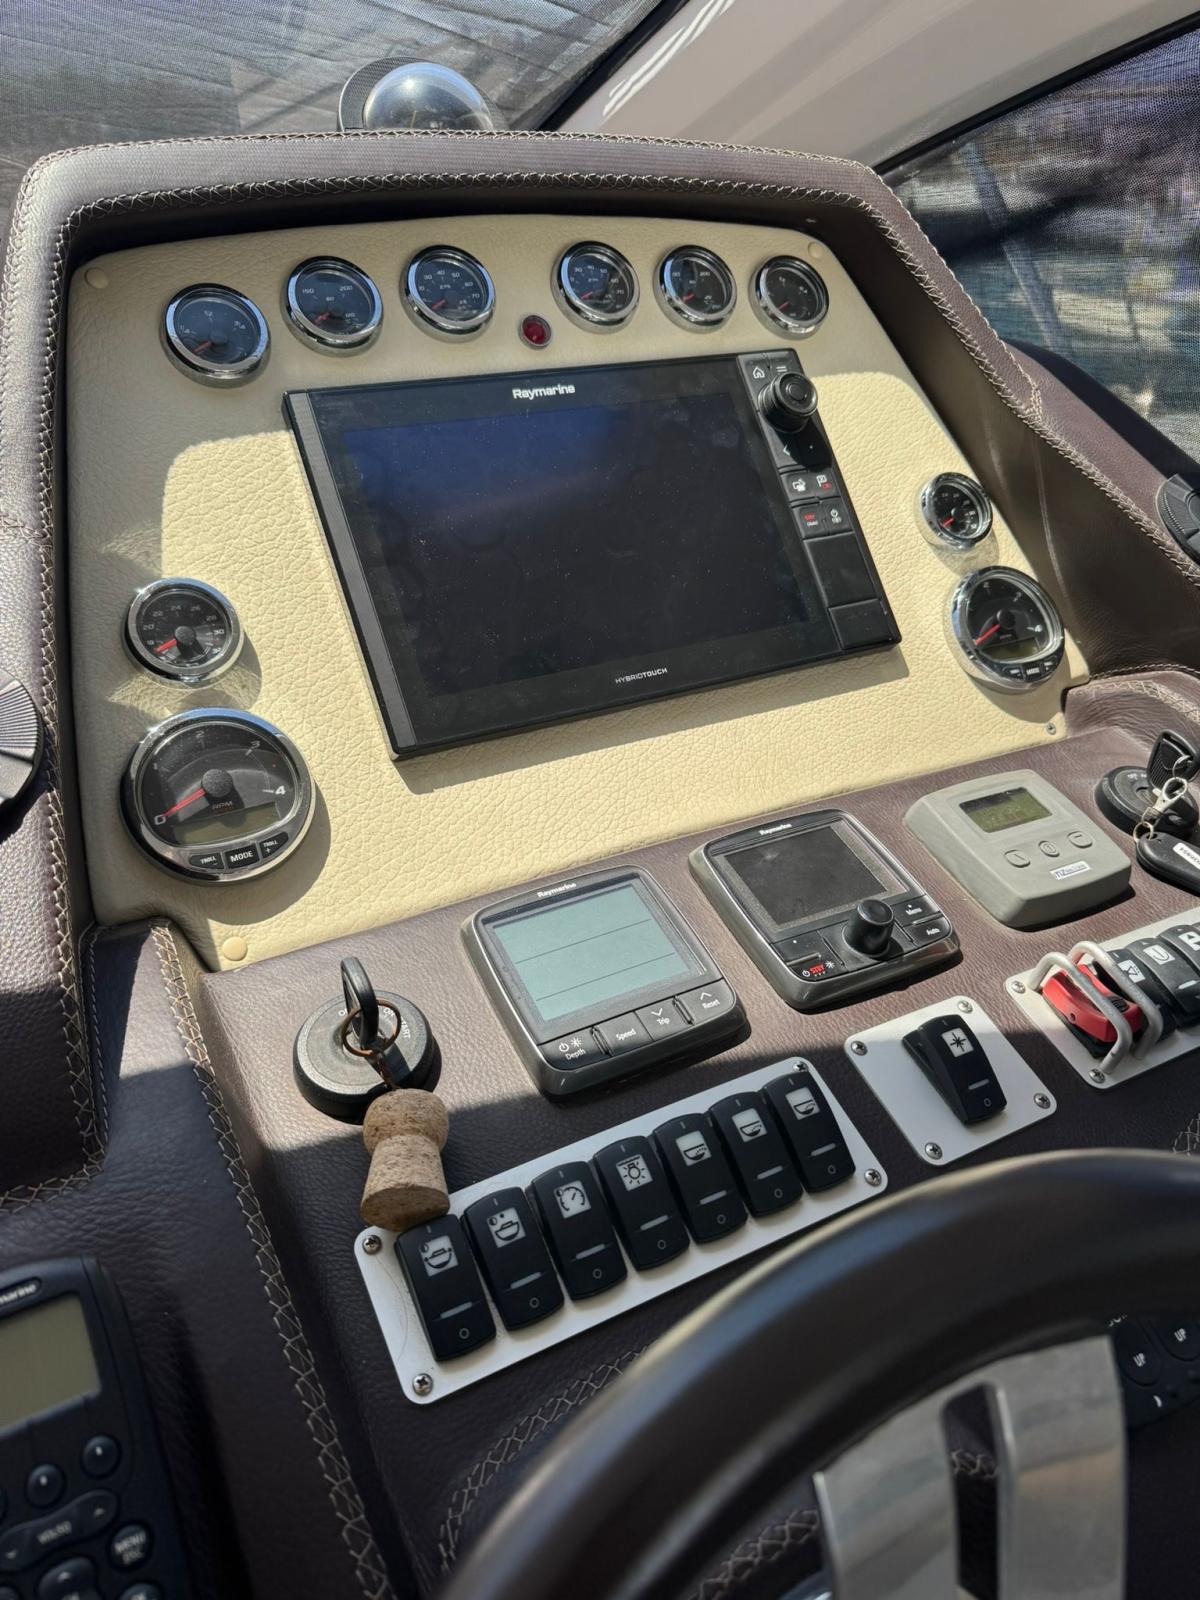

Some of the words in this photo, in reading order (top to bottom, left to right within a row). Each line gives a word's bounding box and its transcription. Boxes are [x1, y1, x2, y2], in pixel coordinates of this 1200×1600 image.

[511, 383, 577, 401] Raymarine
[251, 740, 260, 749] 3
[275, 786, 286, 795] 4
[154, 815, 166, 825] 0
[230, 851, 254, 863] MODE
[536, 883, 577, 898] Raymarine
[702, 999, 721, 1009] Reset
[657, 1016, 671, 1026] Trip
[615, 1028, 637, 1041] Speed
[565, 1048, 587, 1061] Depth
[1174, 1328, 1187, 1342] UP
[1133, 1353, 1146, 1367] UP
